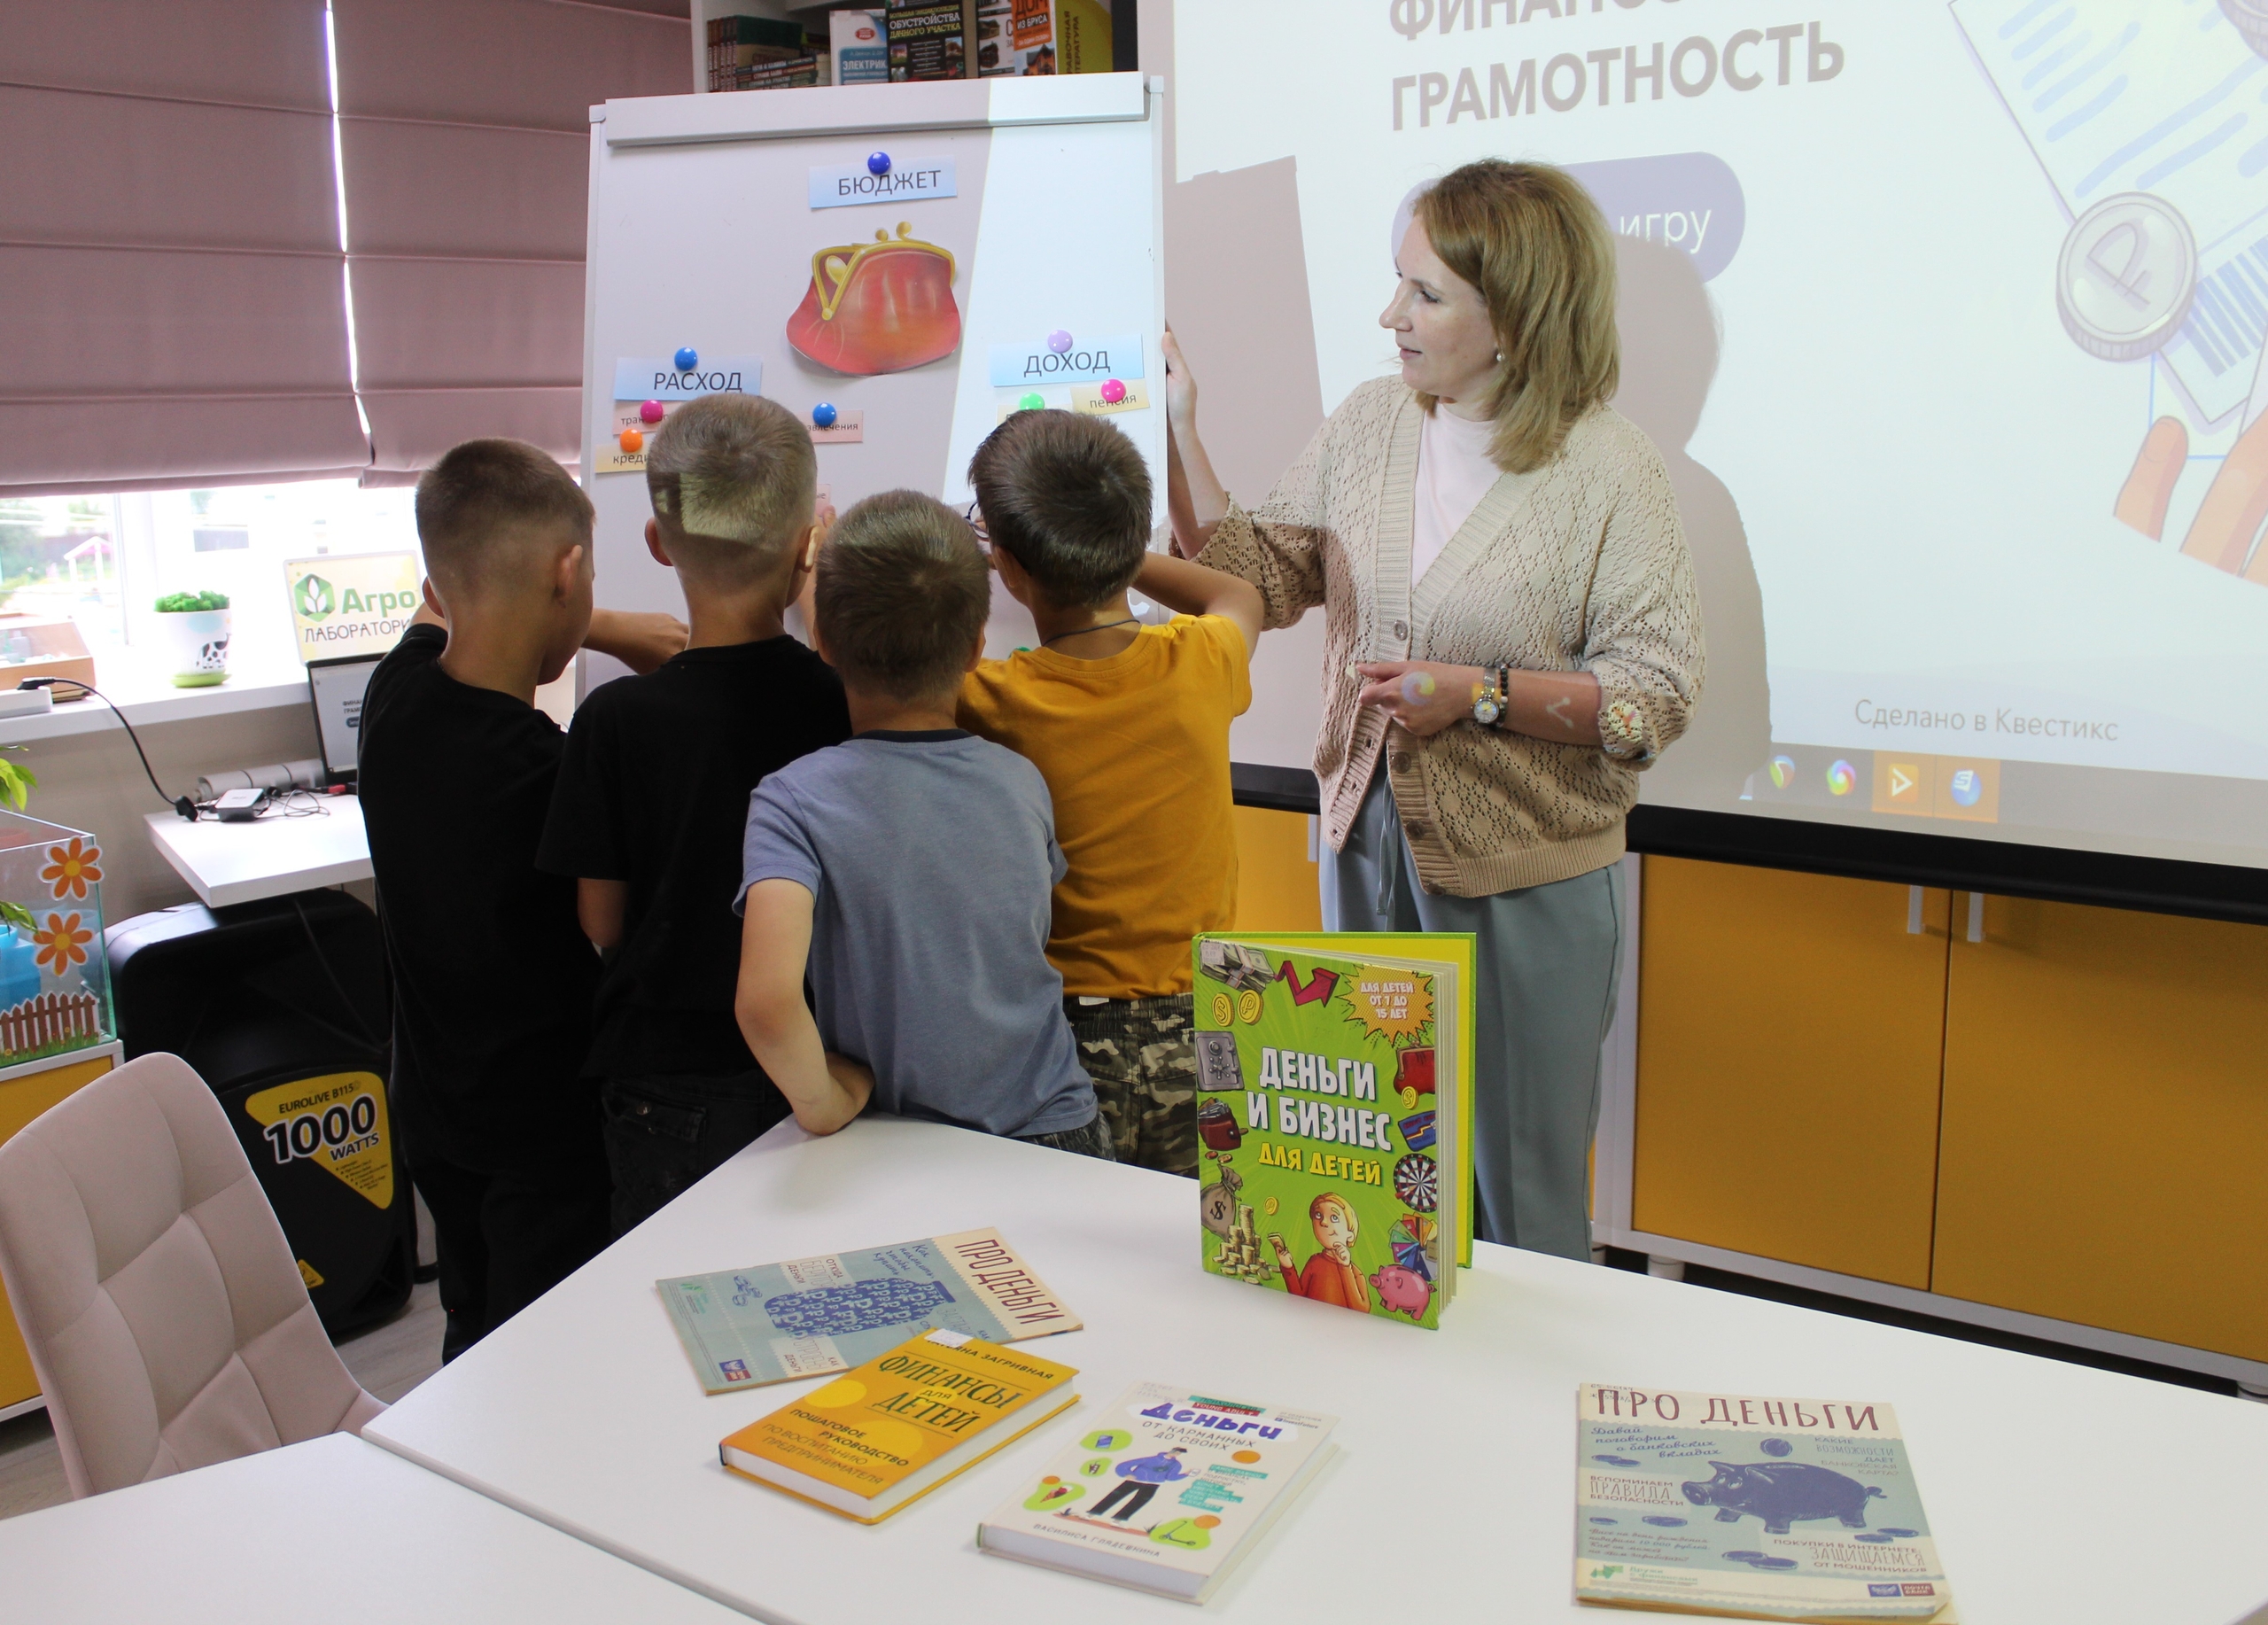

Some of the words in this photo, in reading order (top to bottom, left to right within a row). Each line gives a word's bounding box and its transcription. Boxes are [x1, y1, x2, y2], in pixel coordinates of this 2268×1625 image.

[889, 12, 960, 29] ОБУСТРОЙСТВА
[889, 27, 925, 39] ДАЧНОГО
[928, 23, 961, 34] УЧАСТКА
[1017, 19, 1026, 30] ИЗ
[1027, 14, 1048, 27] БРУСА
[843, 59, 887, 70] ЭЛЕКТРИК
[1393, 20, 1845, 130] ГРАМОТНОСТЬ
[839, 170, 941, 196] БЮДЖЕТ
[1620, 209, 1712, 254] игру
[1024, 351, 1110, 377] ДОХОД
[654, 372, 742, 393] РАСХОД
[341, 588, 416, 618] Агро
[305, 619, 410, 643] ЛАБОРАТОРИ
[1854, 699, 1965, 730] Сделано
[1975, 716, 1986, 732] в
[1996, 708, 2119, 741] Квестикс
[1361, 983, 1380, 993] ДЛЯ
[1383, 982, 1415, 993] ДЕТЕЙ
[1370, 995, 1382, 1006] ОТ
[1384, 995, 1391, 1006] 7
[1394, 996, 1407, 1007] ДО
[1376, 1008, 1388, 1019] 15
[1390, 1008, 1407, 1020] ЛЕТ
[1259, 1046, 1377, 1101] ДЕНЬГИ
[279, 1091, 330, 1114] EUROLIVE
[264, 1093, 377, 1162] 1000
[1247, 1091, 1269, 1130] И
[1278, 1095, 1393, 1151] БИЗНЕС
[330, 1132, 379, 1162] WATTS
[1258, 1142, 1302, 1170] ДЛЯ
[1309, 1151, 1381, 1186] ДЕТЕЙ
[913, 1244, 930, 1258] Как
[954, 1239, 1014, 1270] ПРО
[972, 1270, 1065, 1326] ДЕНЬГИ
[982, 1354, 1054, 1380] ЗАГРИВНАЯ
[879, 1355, 1021, 1411] ФИНАНСЫ
[874, 1391, 981, 1434] ДЕТЕЙ
[1140, 1402, 1283, 1440] Деньги
[1195, 1403, 1223, 1412] YOUNG
[1225, 1407, 1254, 1417] ADULT
[1597, 1388, 1680, 1421] ПРО
[1700, 1397, 1879, 1432] ДЕНЬГИ
[789, 1409, 867, 1439] ПОШАГОВОЕ
[762, 1424, 783, 1434] ПО
[781, 1430, 867, 1466] ВОСПИТАНИЮ
[819, 1430, 910, 1466] РУКОВОДСТВО
[1166, 1426, 1256, 1448] КАРМАННЫХ
[1180, 1435, 1230, 1450] СВОИХ
[1629, 1440, 1716, 1450] банковских
[762, 1436, 884, 1484] ПРЕДПРИНИМАТЕЛЯ
[1816, 1444, 1894, 1456] ВОЗМОЖНОСТИ
[1821, 1460, 1897, 1469] БАНКОВСКАЯ
[1590, 1475, 1674, 1487] ВСПОМИНАЕМ
[1590, 1481, 1670, 1500] ПРАВИЛА
[1590, 1494, 1684, 1506] БЕЗОПАСНОСТИ
[1033, 1523, 1087, 1541] ВАСИЛИСА
[1091, 1536, 1161, 1558] ГЛЯДЕШКИНА
[1774, 1538, 1835, 1548] ПОКУПКИ
[1812, 1547, 1925, 1567] ЗАЩИЩАЕМСЯ
[1833, 1562, 1927, 1573] МОШЕННИКОВ
